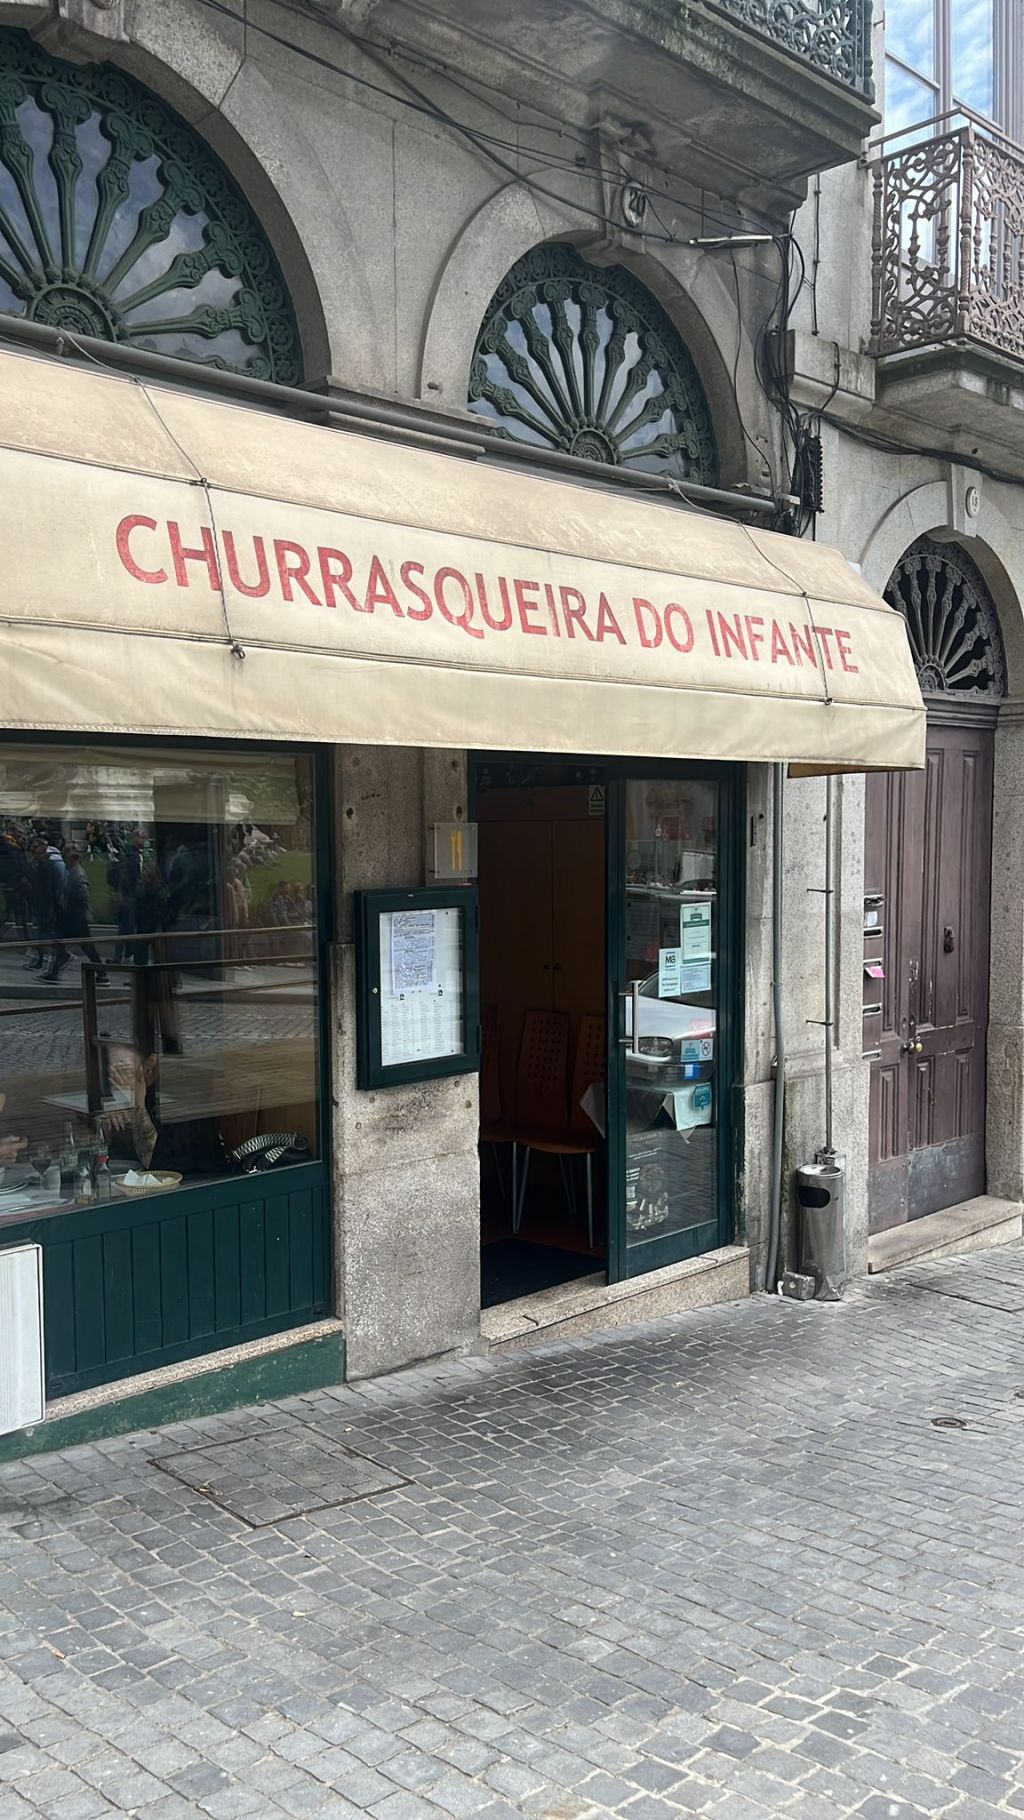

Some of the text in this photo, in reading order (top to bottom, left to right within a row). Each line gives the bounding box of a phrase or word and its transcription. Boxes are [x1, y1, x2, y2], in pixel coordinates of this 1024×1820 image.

[629, 189, 646, 217] 20
[116, 514, 859, 674] CHURRASQUEIRA DO INFANTE
